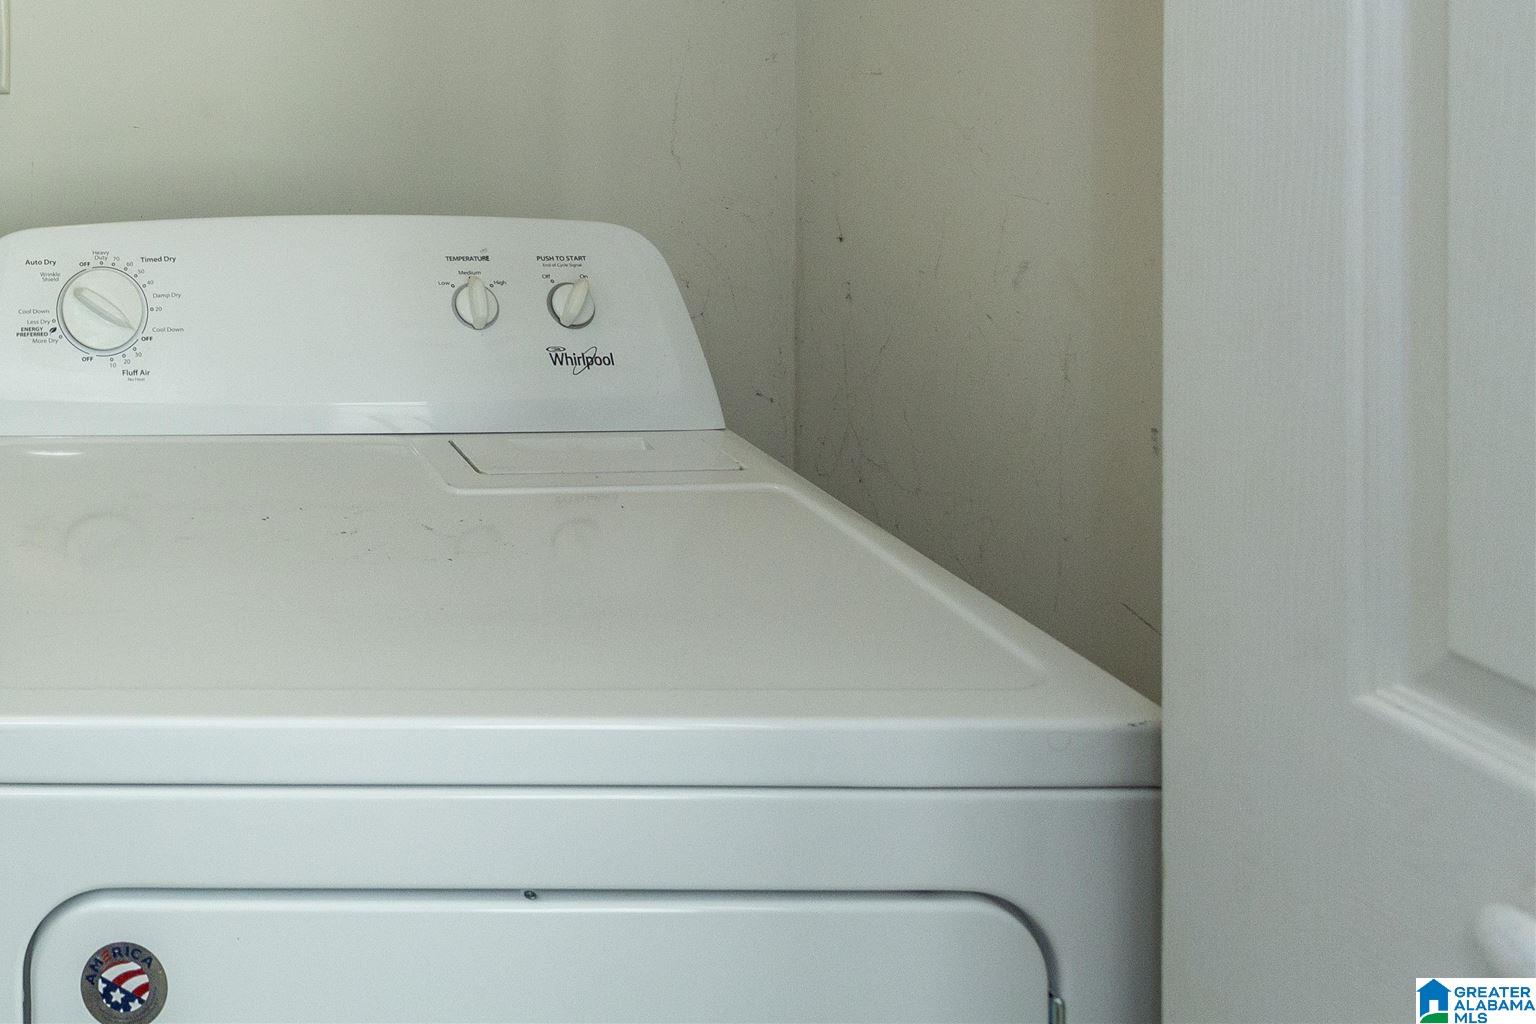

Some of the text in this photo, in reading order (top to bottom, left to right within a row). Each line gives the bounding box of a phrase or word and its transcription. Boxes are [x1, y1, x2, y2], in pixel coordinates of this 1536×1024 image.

[163, 255, 177, 263] Dry
[493, 279, 507, 287] High
[549, 352, 615, 370] Whirlpool
[85, 946, 153, 986] AMERICA
